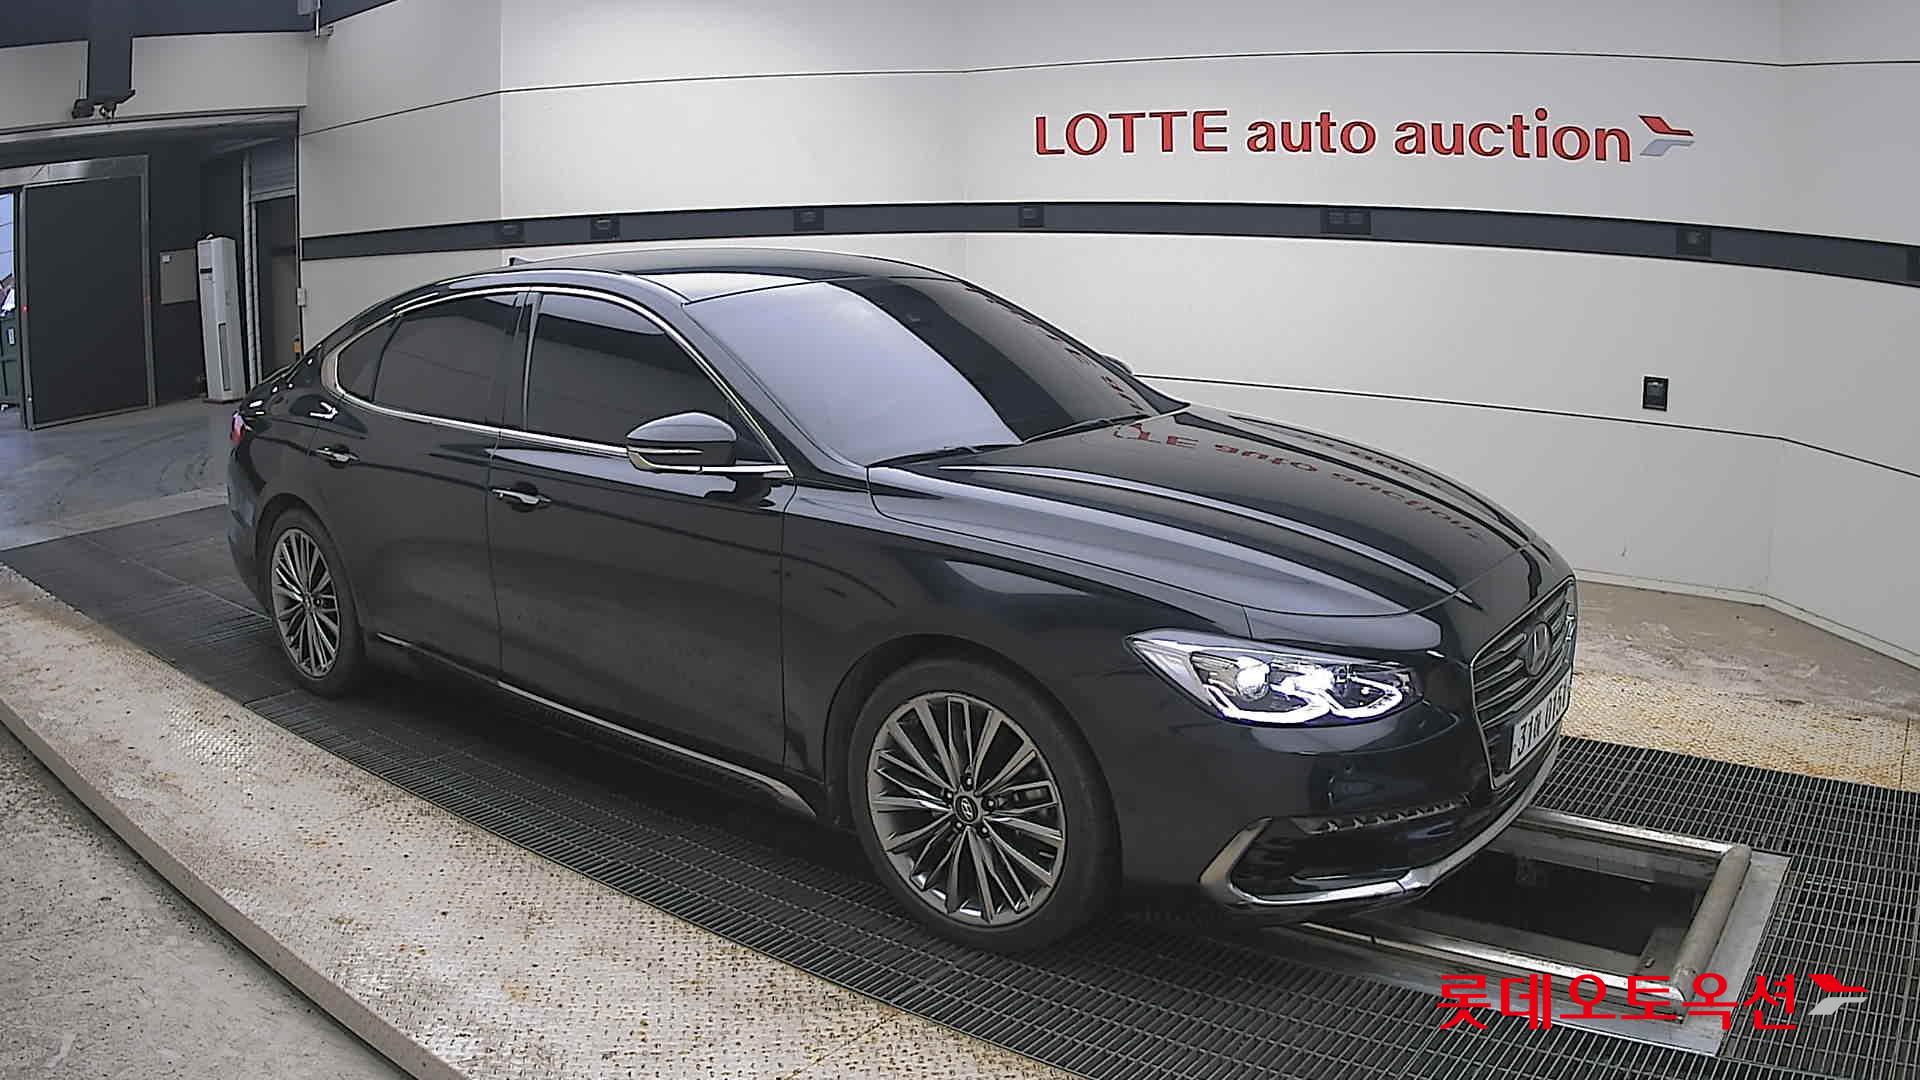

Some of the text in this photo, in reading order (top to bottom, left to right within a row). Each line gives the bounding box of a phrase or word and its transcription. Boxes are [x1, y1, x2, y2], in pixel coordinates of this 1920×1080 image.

[1035, 107, 1631, 162] LOTTE auto auction
